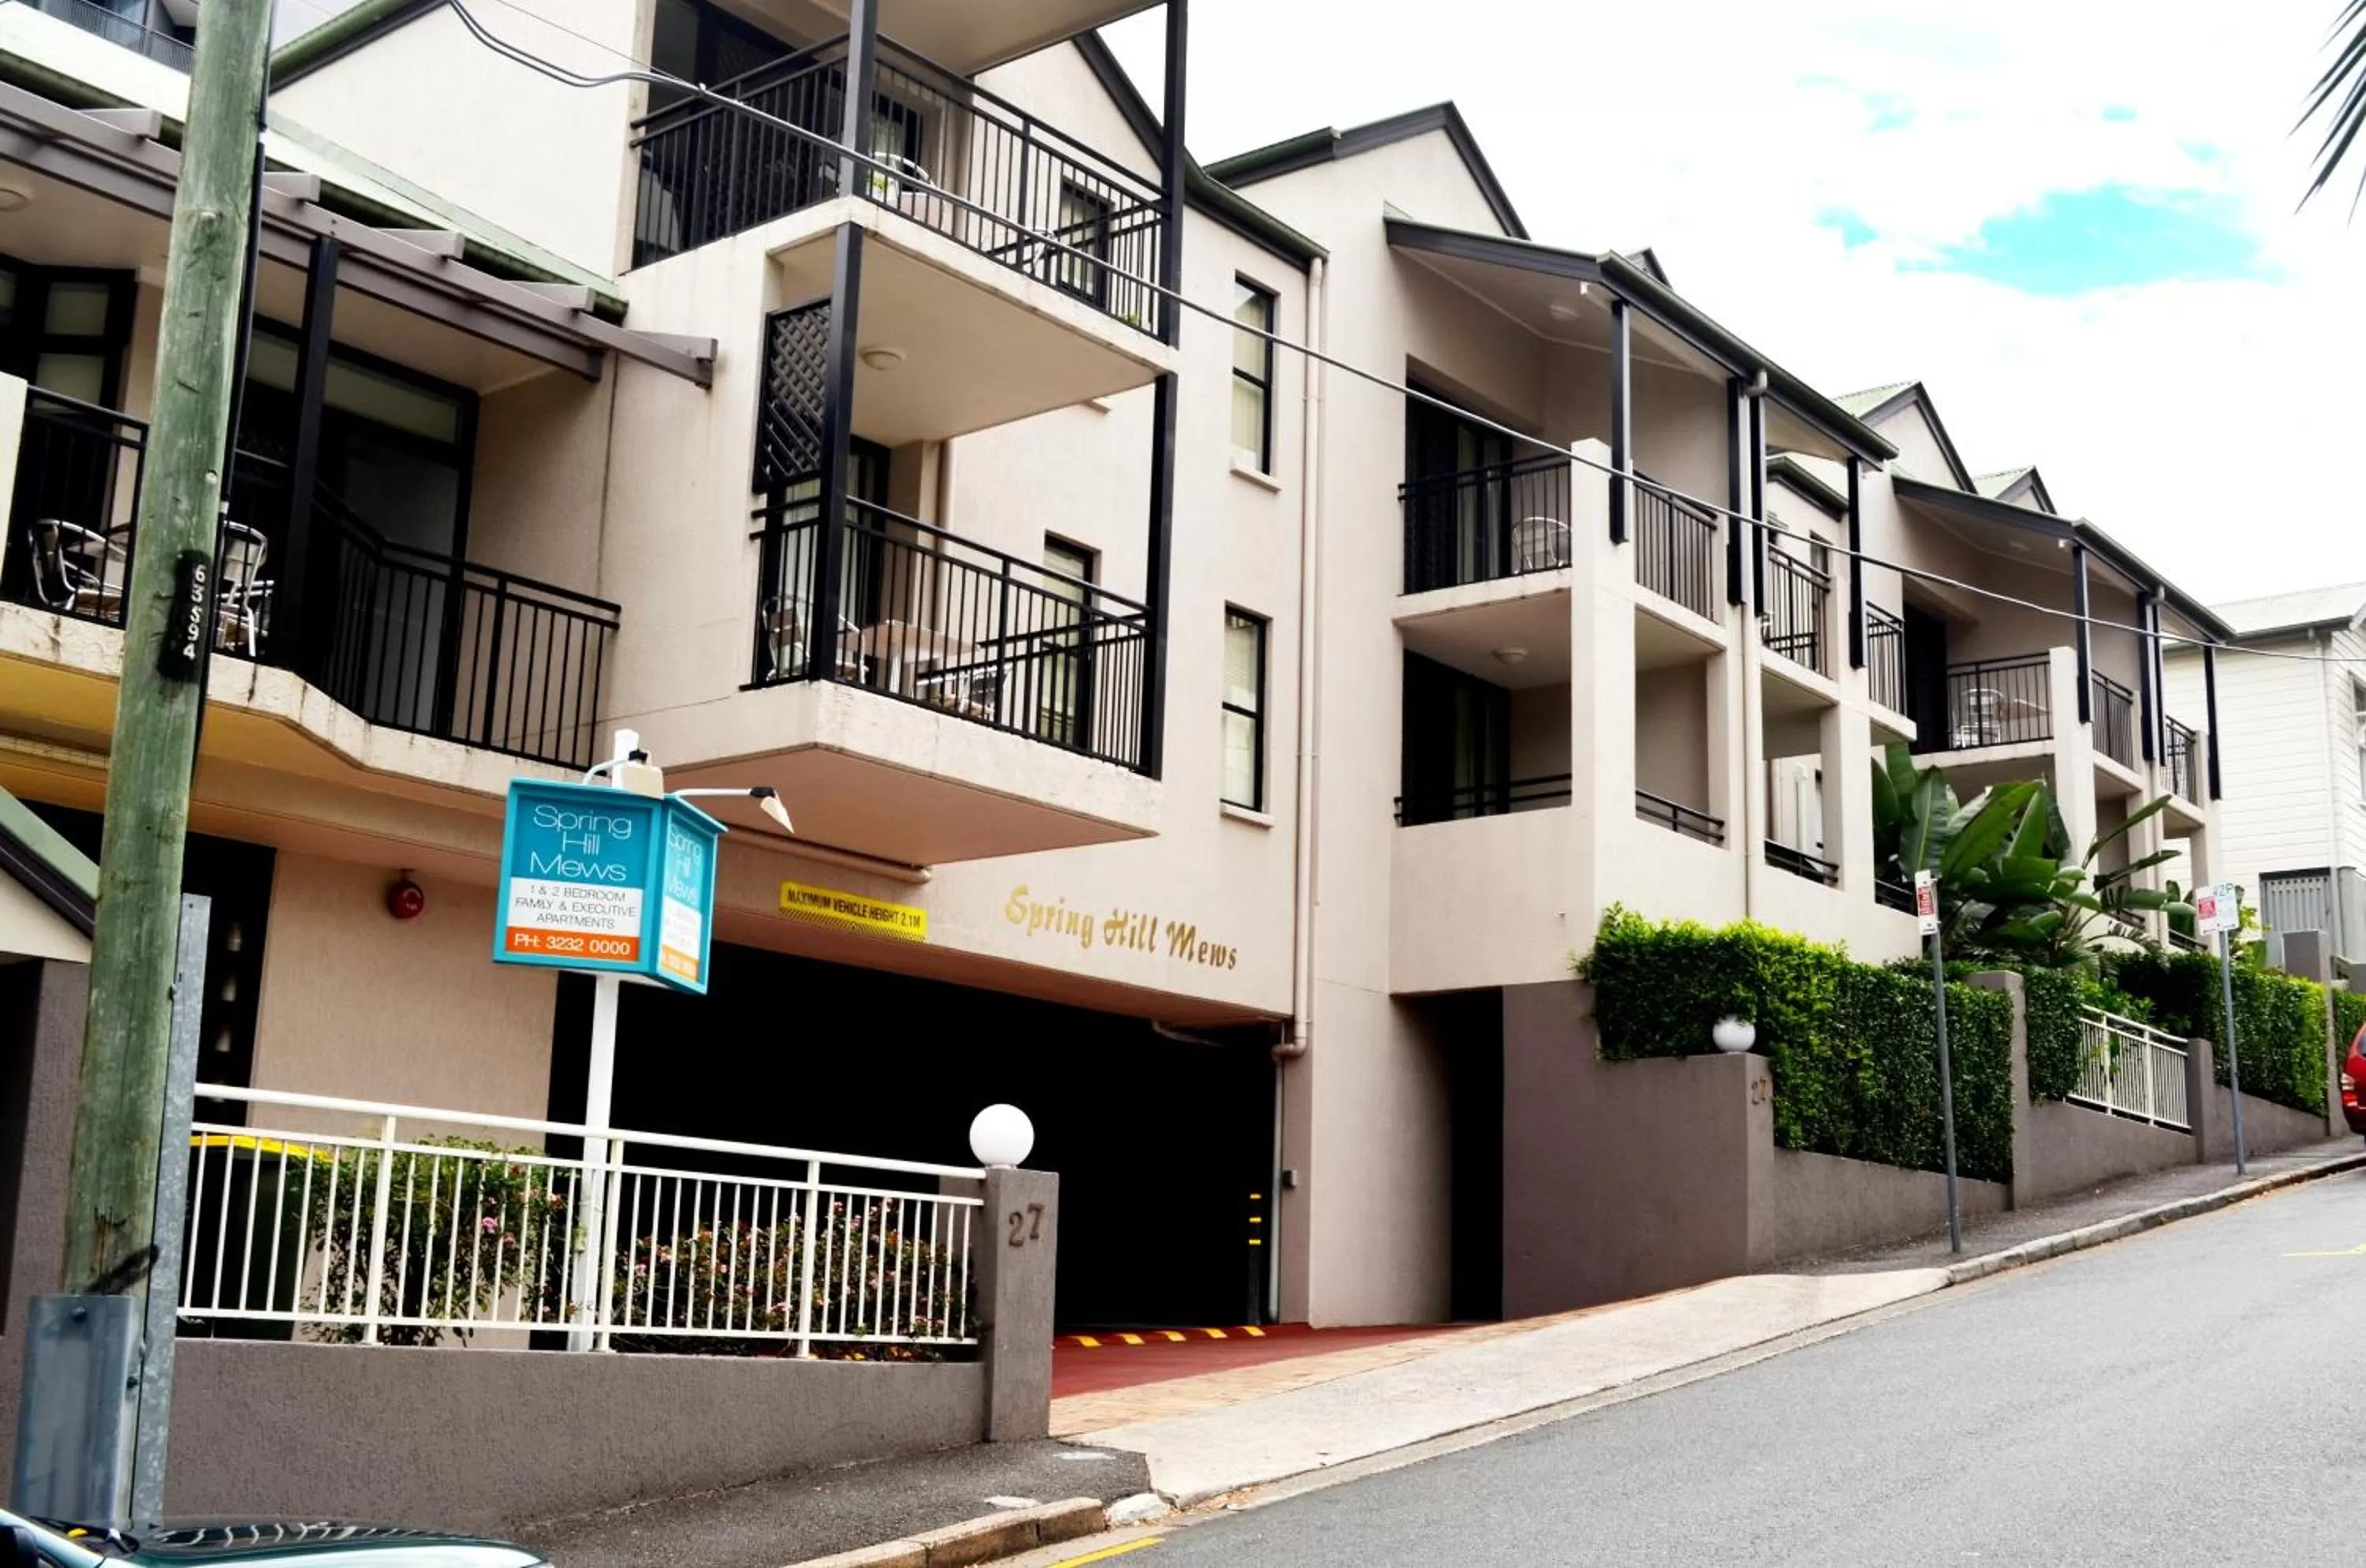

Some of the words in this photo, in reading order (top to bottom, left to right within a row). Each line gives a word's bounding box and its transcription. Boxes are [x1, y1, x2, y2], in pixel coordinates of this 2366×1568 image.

[533, 805, 632, 840] Spring
[562, 831, 600, 856] Hill
[529, 851, 628, 882] Mews
[515, 897, 553, 909] FAMILY
[558, 902, 568, 912] &
[572, 902, 638, 917] EXECUTIVE
[538, 885, 547, 896] &
[552, 886, 561, 897] 2
[564, 887, 625, 902] BEDROOM
[536, 913, 616, 930] APARTMENTS
[787, 889, 830, 909] MAXIMUM
[834, 898, 867, 919] VEHICLE
[868, 905, 899, 927] HEIGHT
[900, 912, 921, 929] 2.1M
[1006, 883, 1095, 950] Spring
[1103, 908, 1158, 954] Hill
[1166, 920, 1237, 970] Mews
[546, 935, 584, 952] 3232
[589, 939, 631, 955] 0000
[1009, 1202, 1045, 1248] 27
